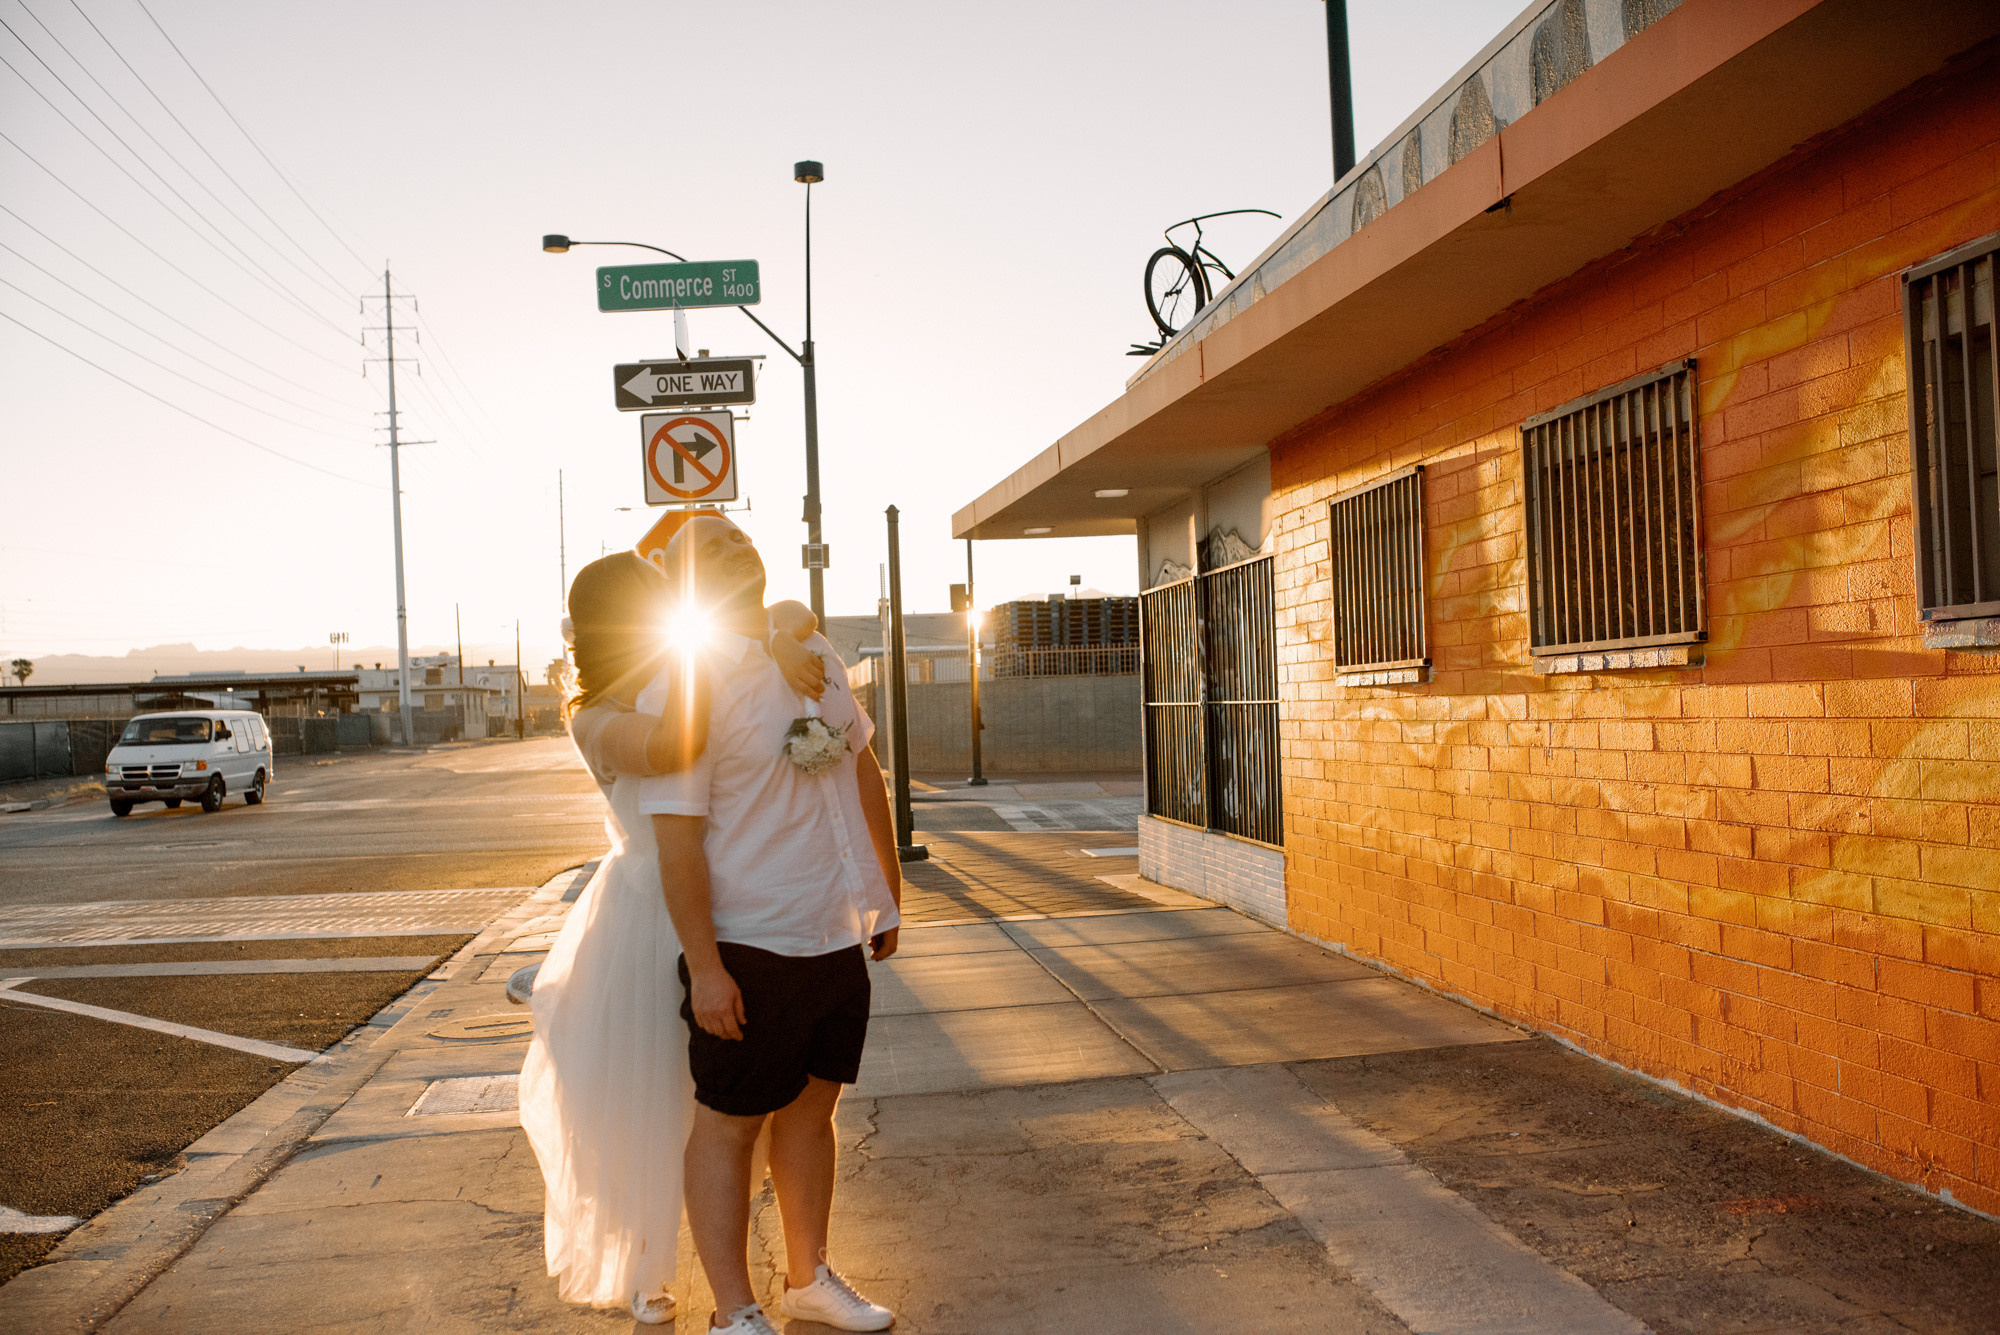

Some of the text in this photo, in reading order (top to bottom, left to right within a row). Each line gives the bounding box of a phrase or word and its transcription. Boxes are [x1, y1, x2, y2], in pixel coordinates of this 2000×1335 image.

[603, 269, 737, 300] S Commerce ST
[723, 284, 754, 297] 1400
[656, 373, 738, 393] ONE WAY
